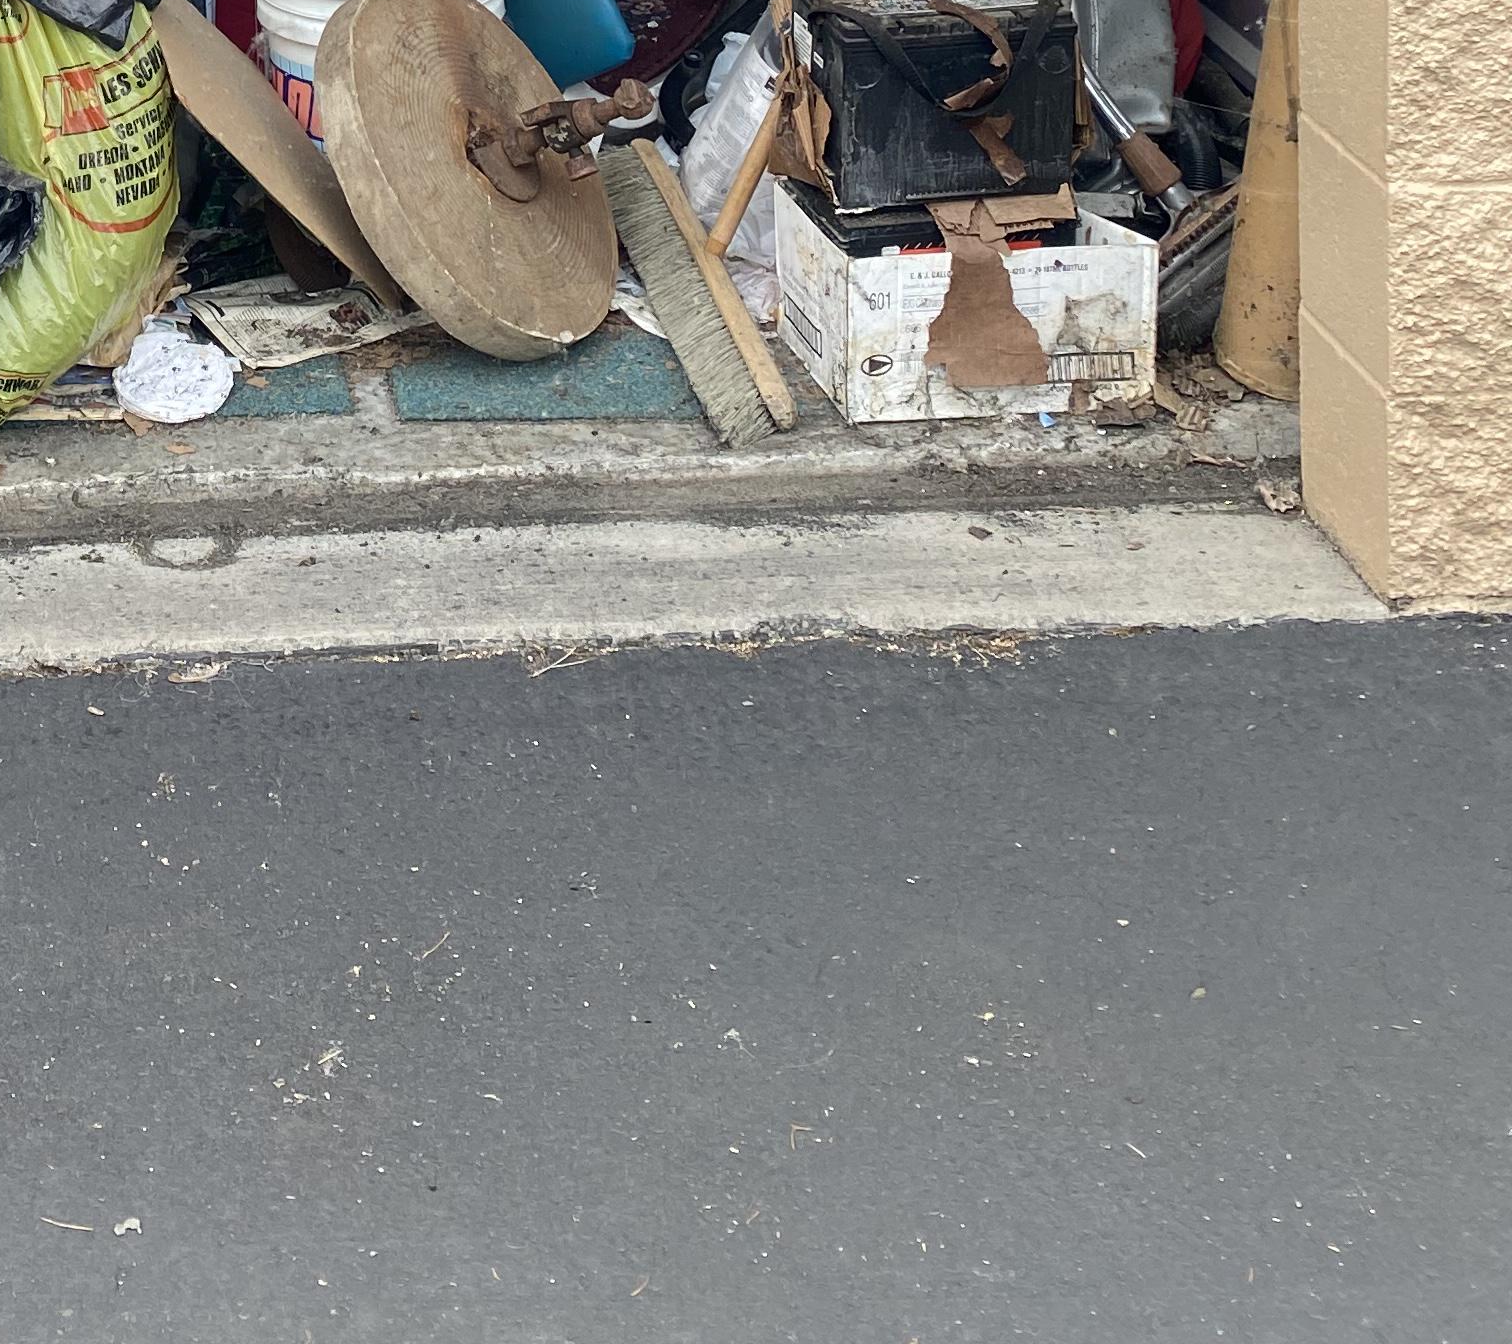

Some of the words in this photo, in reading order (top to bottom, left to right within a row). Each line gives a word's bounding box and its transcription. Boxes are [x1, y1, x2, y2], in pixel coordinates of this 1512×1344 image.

[100, 72, 132, 105] LES
[79, 142, 130, 170] OREGON
[113, 148, 166, 186] MONTANA
[115, 173, 160, 208] NEVADA
[869, 292, 892, 311] 601
